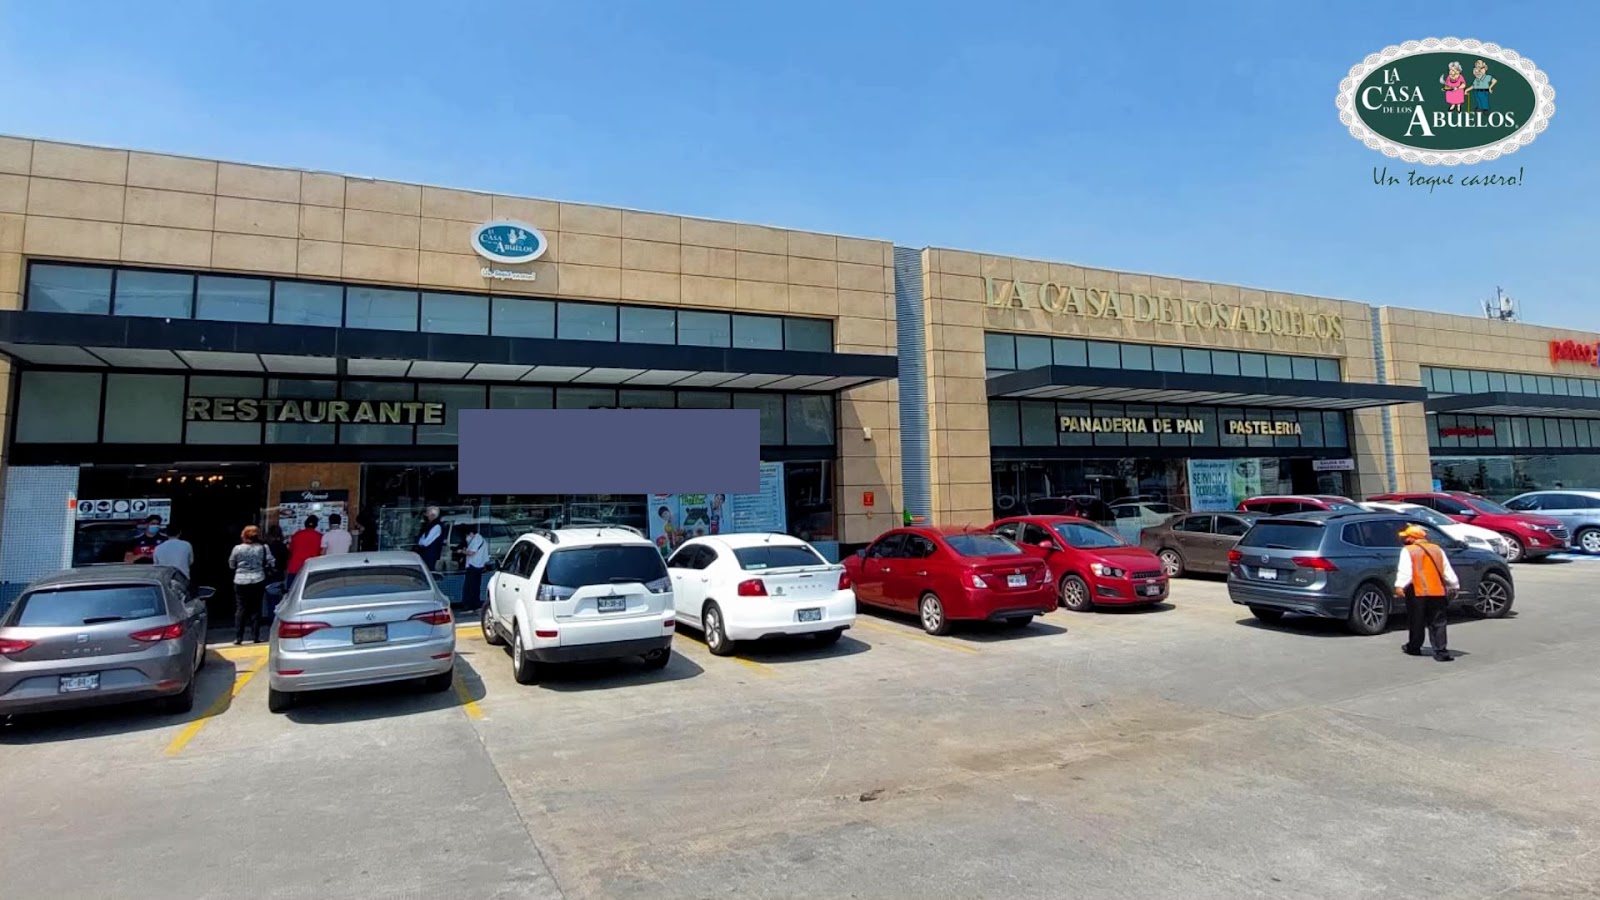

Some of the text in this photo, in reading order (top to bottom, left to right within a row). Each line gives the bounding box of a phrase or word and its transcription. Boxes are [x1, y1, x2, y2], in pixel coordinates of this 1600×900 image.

[480, 233, 503, 243] CASA
[984, 276, 1344, 340] LA CASA DE LOS ABUELOS
[186, 398, 443, 424] RESTAURANTE
[1059, 416, 1204, 434] PANADERIA DE PAN
[1229, 420, 1302, 436] PASTELERIA
